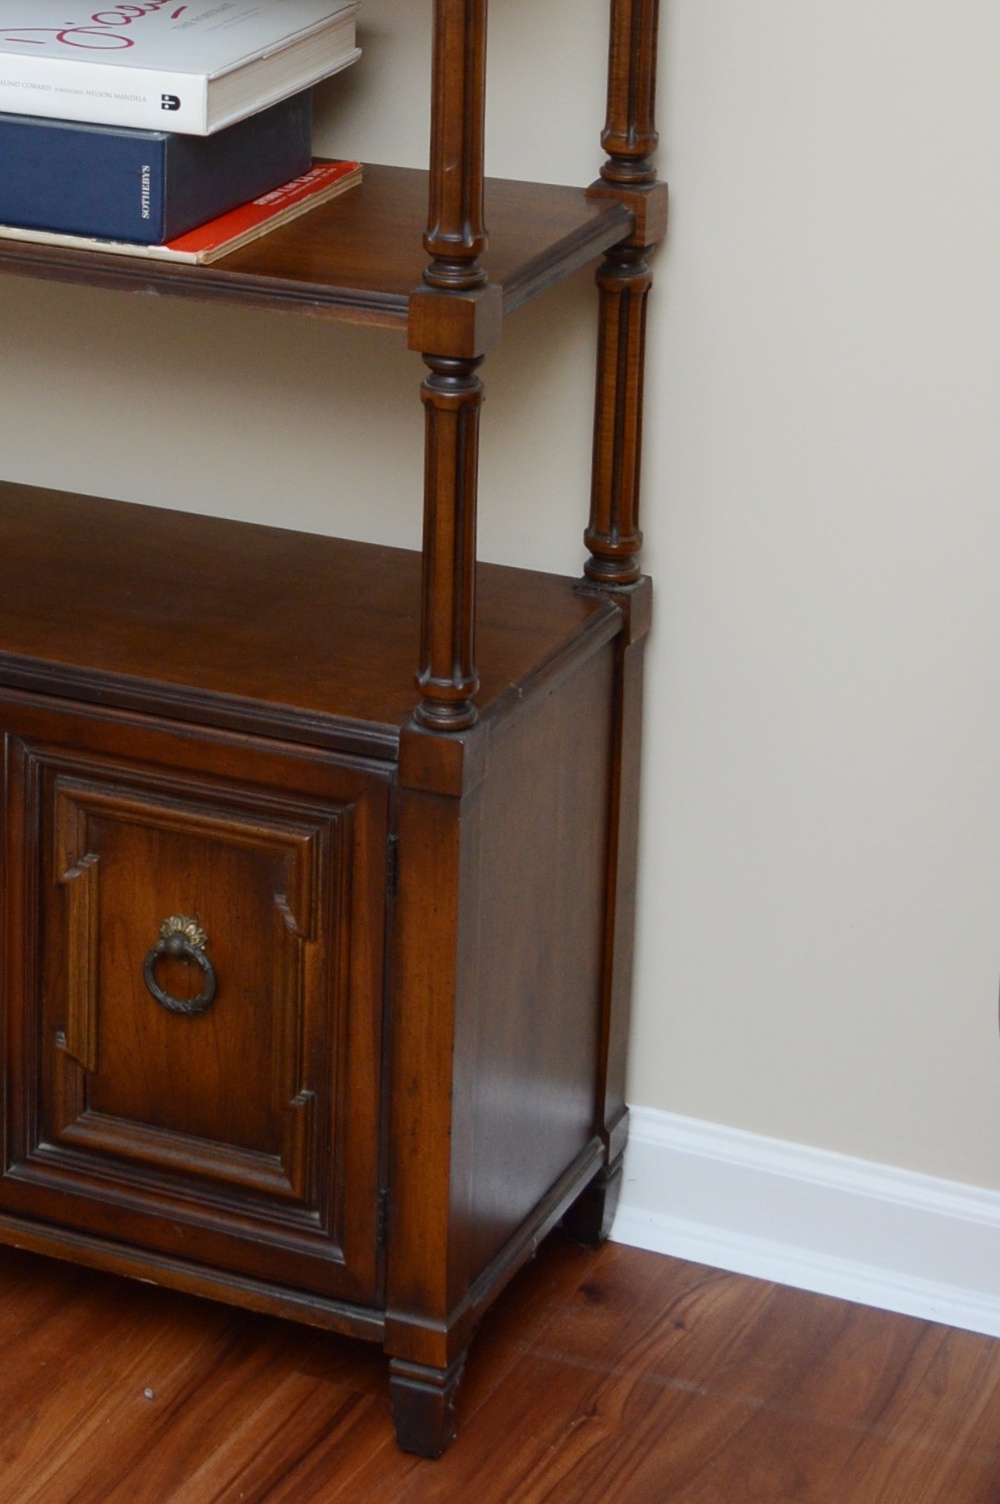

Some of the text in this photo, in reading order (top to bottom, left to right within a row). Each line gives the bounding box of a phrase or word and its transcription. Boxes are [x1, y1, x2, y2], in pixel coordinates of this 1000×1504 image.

[22, 81, 51, 91] COWARD
[86, 90, 113, 99] NELSON
[114, 93, 147, 103] MANDELA
